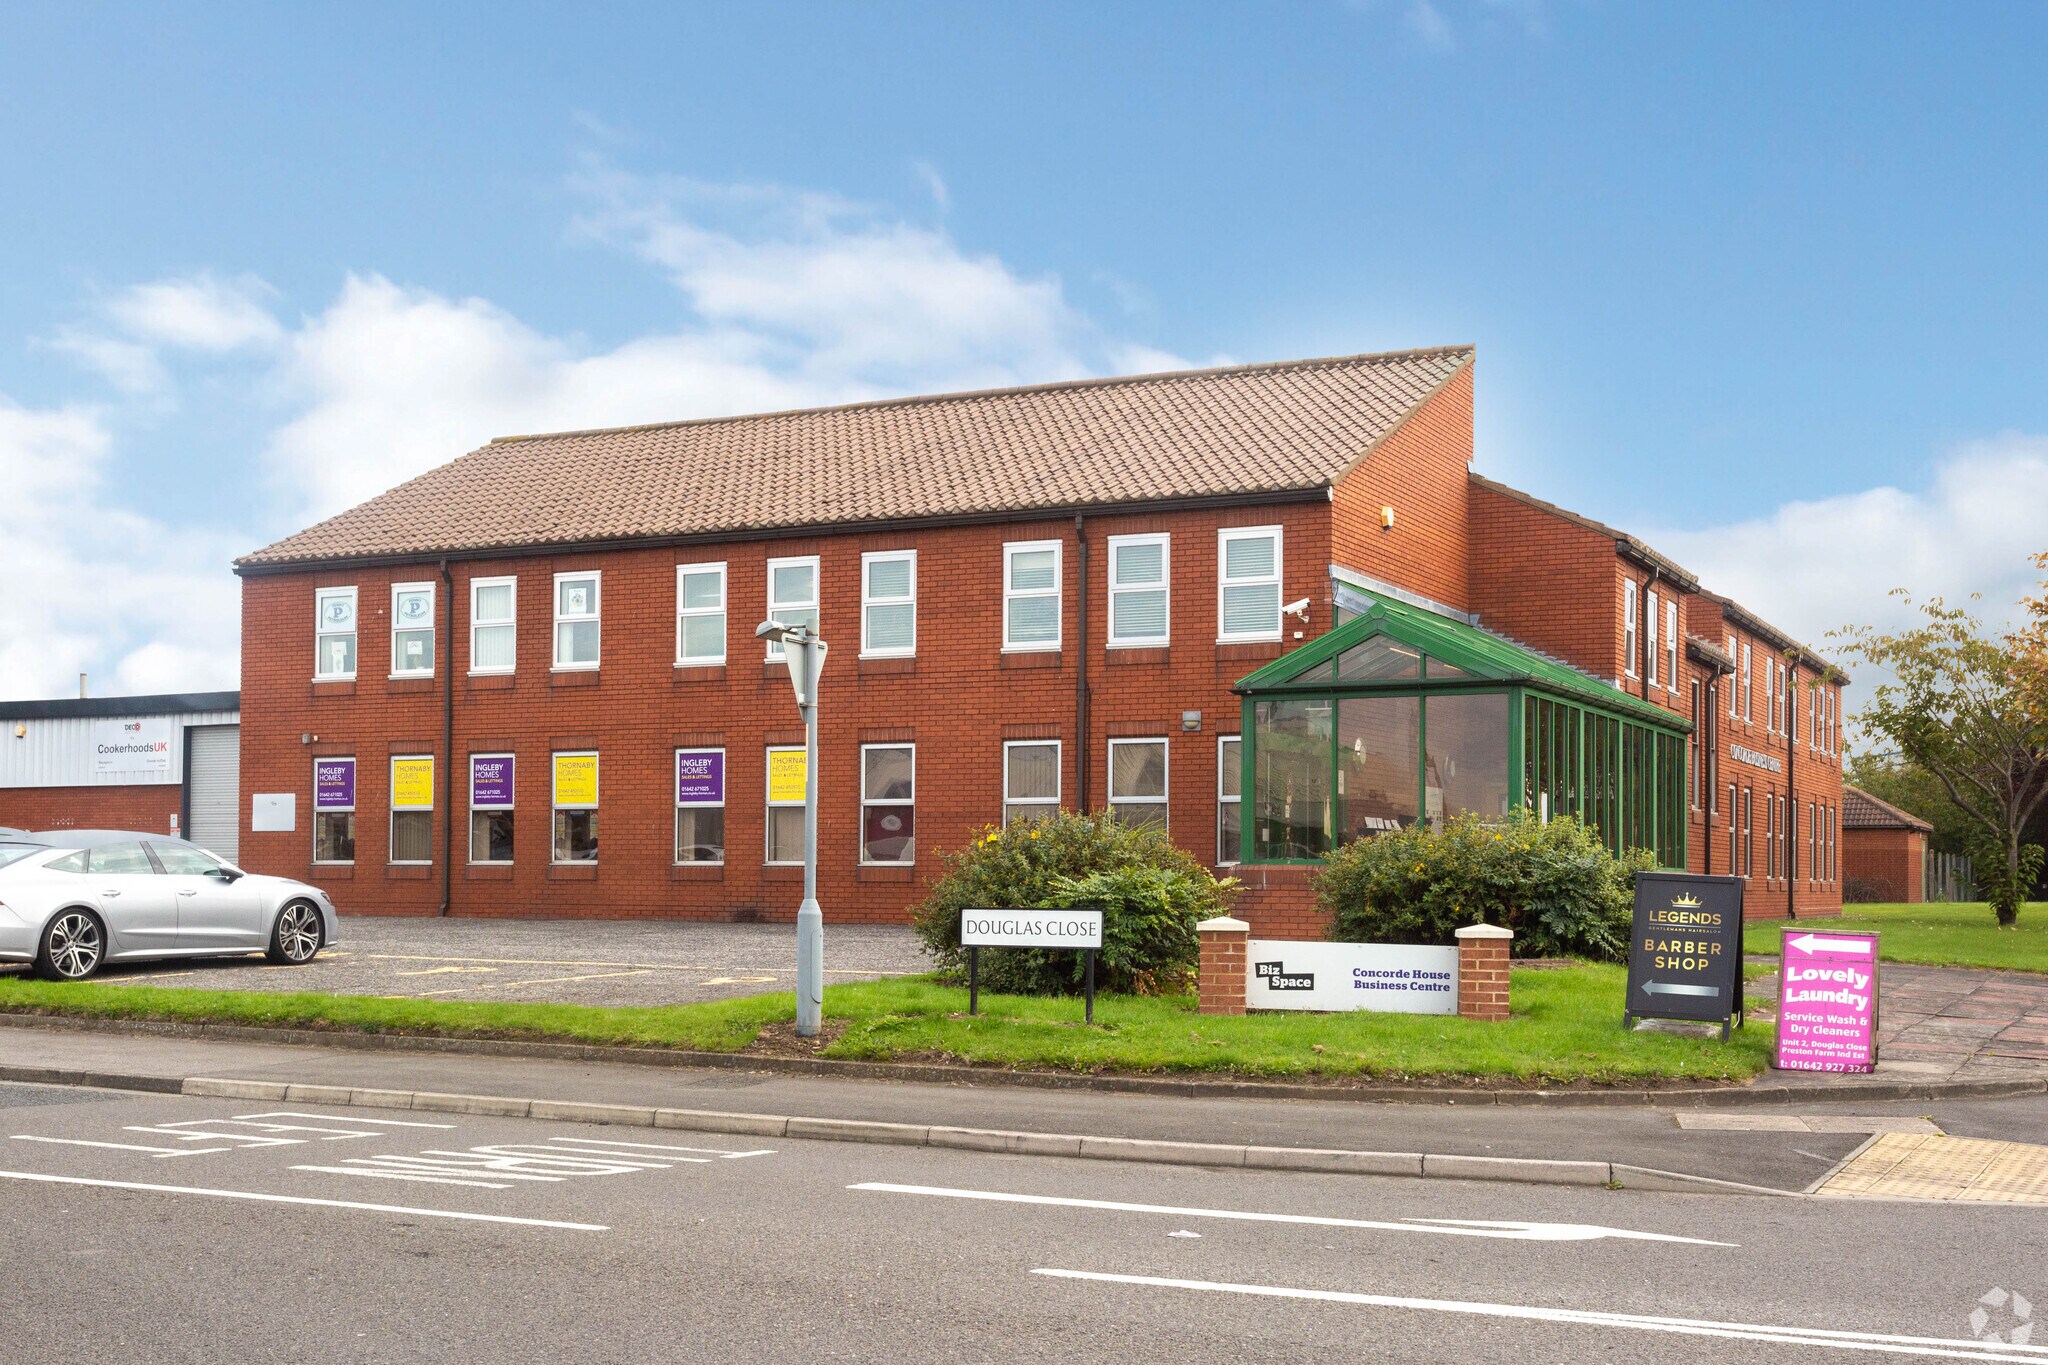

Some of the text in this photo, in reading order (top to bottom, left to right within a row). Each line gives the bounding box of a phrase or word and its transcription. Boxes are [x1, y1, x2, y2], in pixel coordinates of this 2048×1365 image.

[333, 607, 343, 618] P
[410, 603, 420, 613] P
[124, 722, 140, 731] DECO
[97, 742, 167, 754] CookerhoodsUK
[475, 763, 504, 771] INGLEBY
[558, 761, 595, 769] THORNABY
[681, 758, 712, 767] INGLEBY
[772, 764, 799, 772] HOMES
[475, 770, 499, 778] HOMES
[558, 769, 582, 777] HOMES
[681, 766, 708, 774] HOMES
[319, 774, 342, 782] HOMES
[1649, 910, 1722, 925] LEGENDS
[966, 920, 1097, 936] DOUGLAS CLOSE
[1644, 939, 1722, 955] BARBER
[1259, 964, 1280, 975] Biz
[1654, 956, 1709, 971] SHOP
[1352, 968, 1451, 980] Concorde House
[1786, 966, 1870, 990] Lovely
[1272, 976, 1311, 988] Space
[1354, 980, 1451, 992] Business Centre
[1785, 987, 1869, 1012] Laundry
[1784, 1012, 1869, 1026] Service Wash &
[1790, 1024, 1861, 1037] Dry Cleaners
[1782, 1038, 1868, 1051] Unit 2, Douglas Close
[1781, 1047, 1812, 1055] Preston
[1837, 1050, 1851, 1058] Ind
[1852, 1051, 1865, 1059] Est
[1780, 1060, 1867, 1073] t: 01642 927 324
